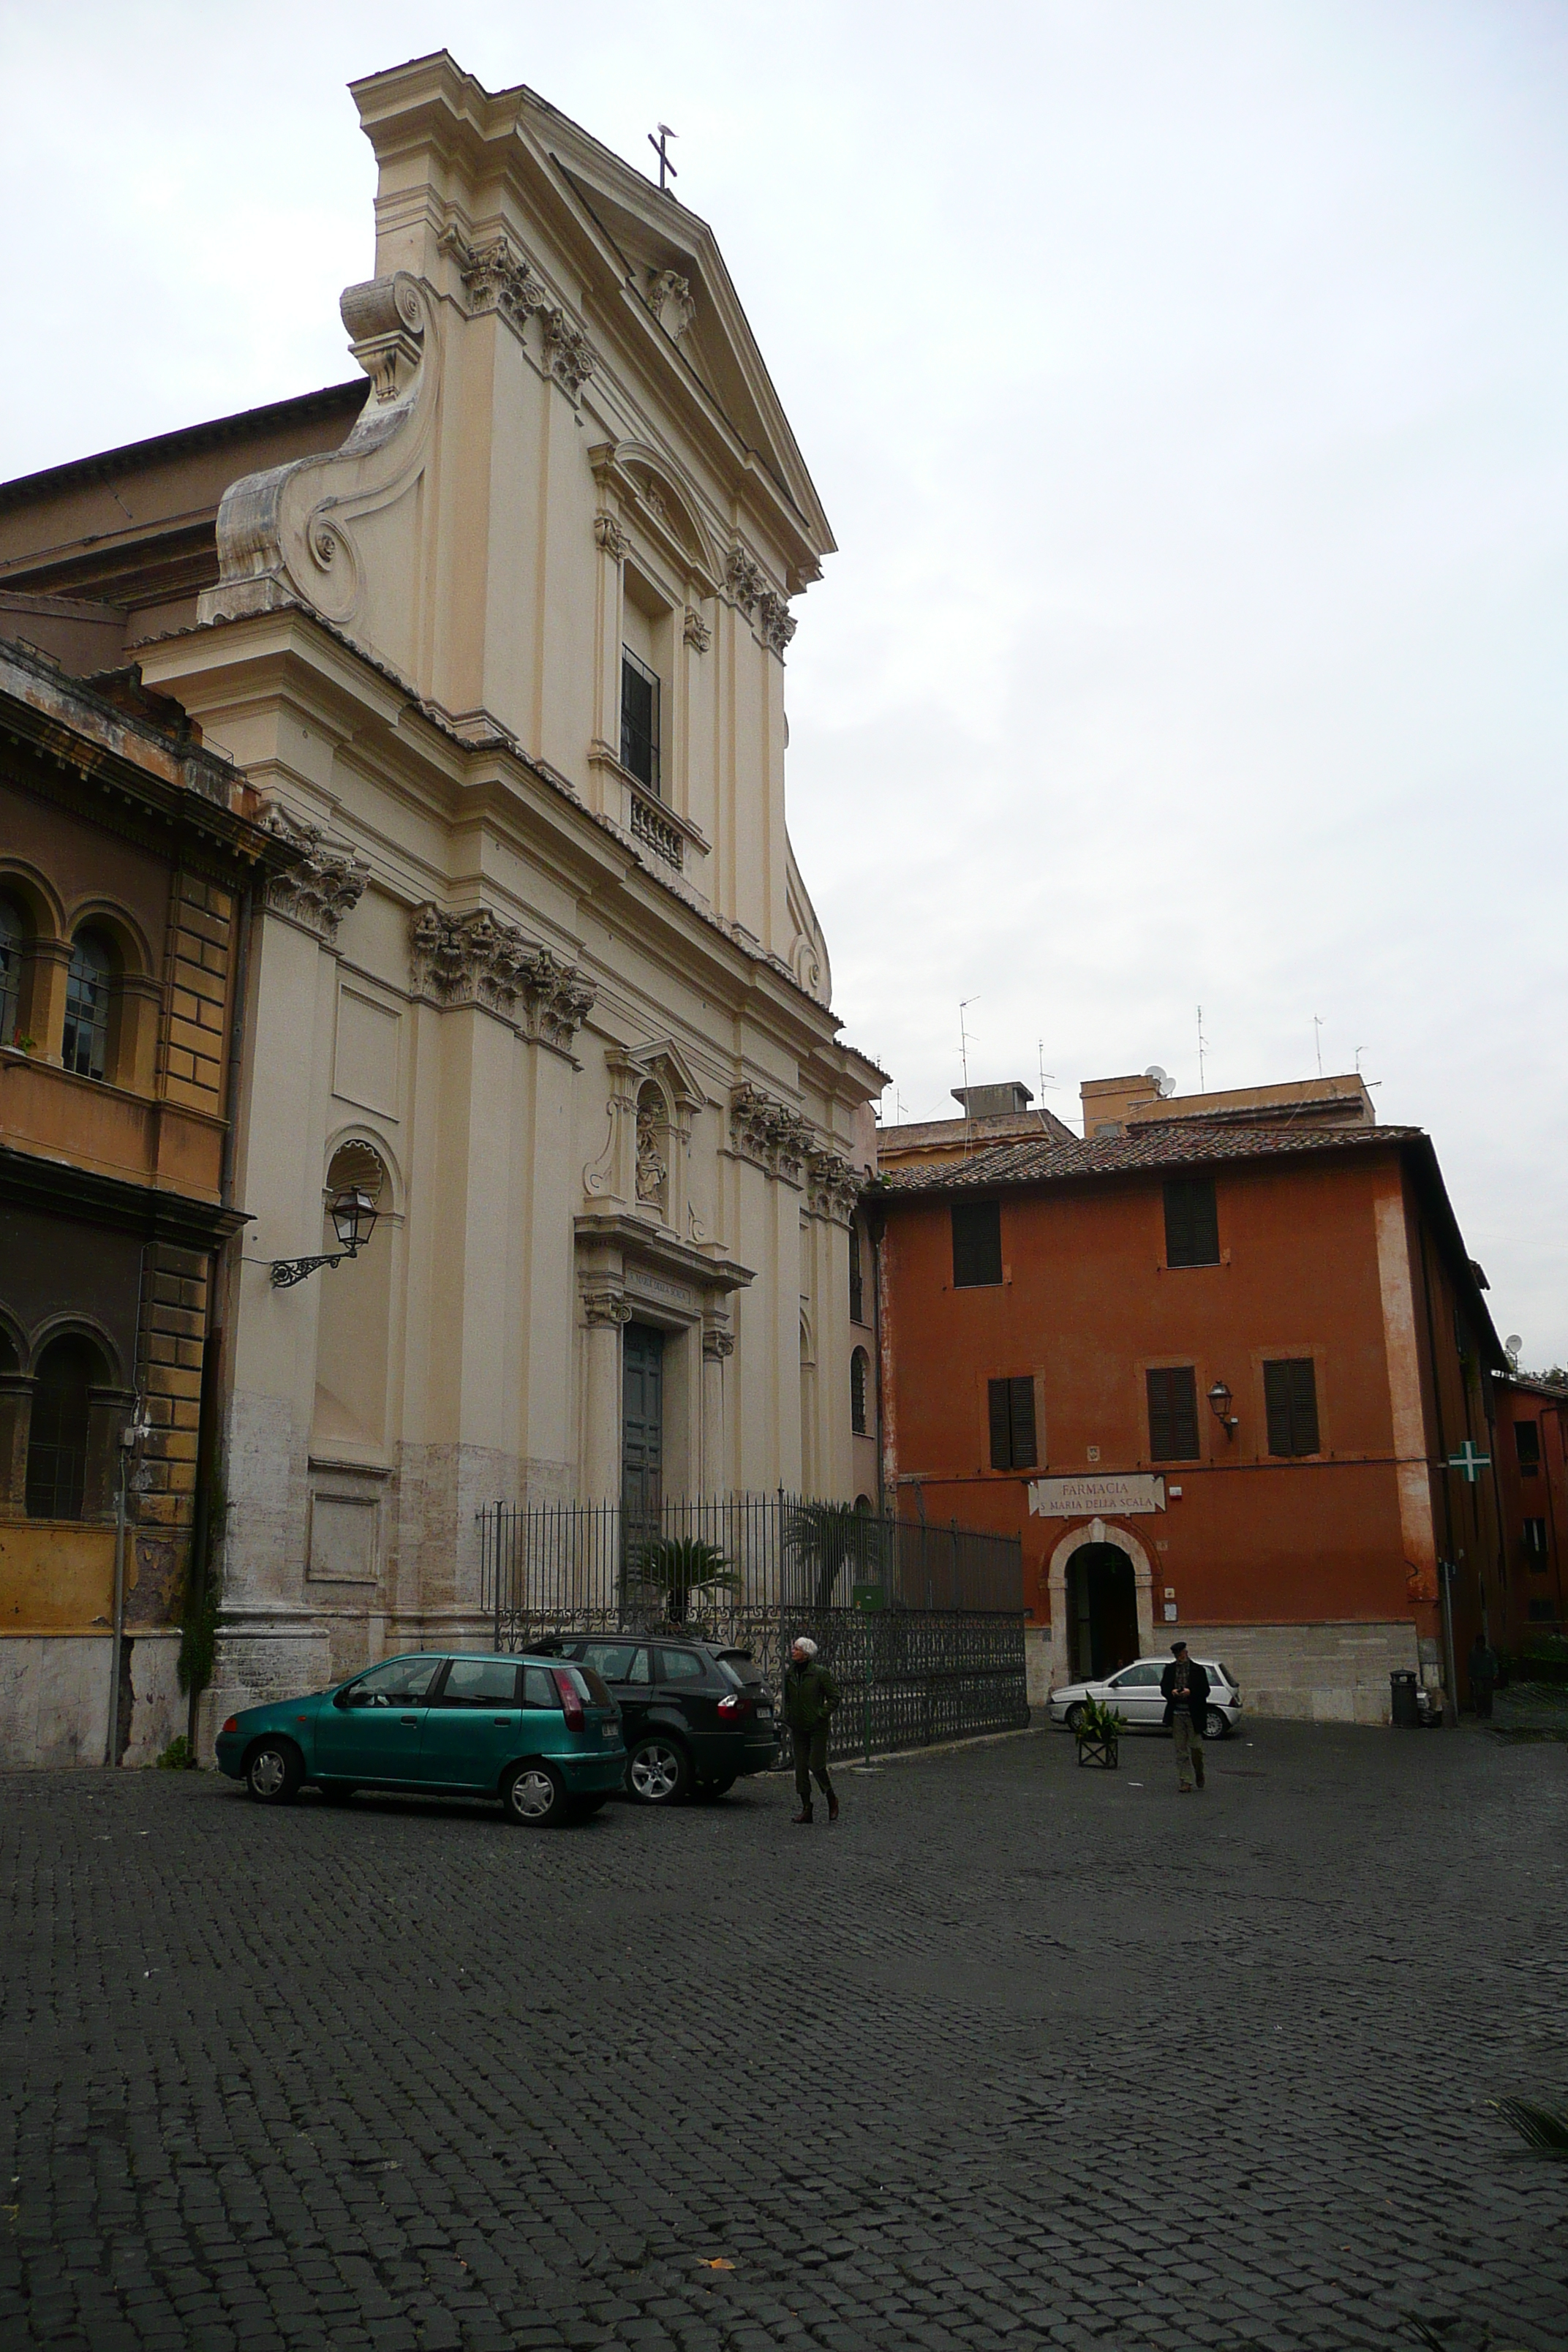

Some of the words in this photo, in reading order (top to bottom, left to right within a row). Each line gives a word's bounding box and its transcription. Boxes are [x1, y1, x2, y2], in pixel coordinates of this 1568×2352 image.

[1063, 1482, 1128, 1496] FARMACIA
[1050, 1500, 1082, 1510] MARIA
[1085, 1499, 1117, 1509] DELLA
[1120, 1497, 1153, 1507] SCALA
